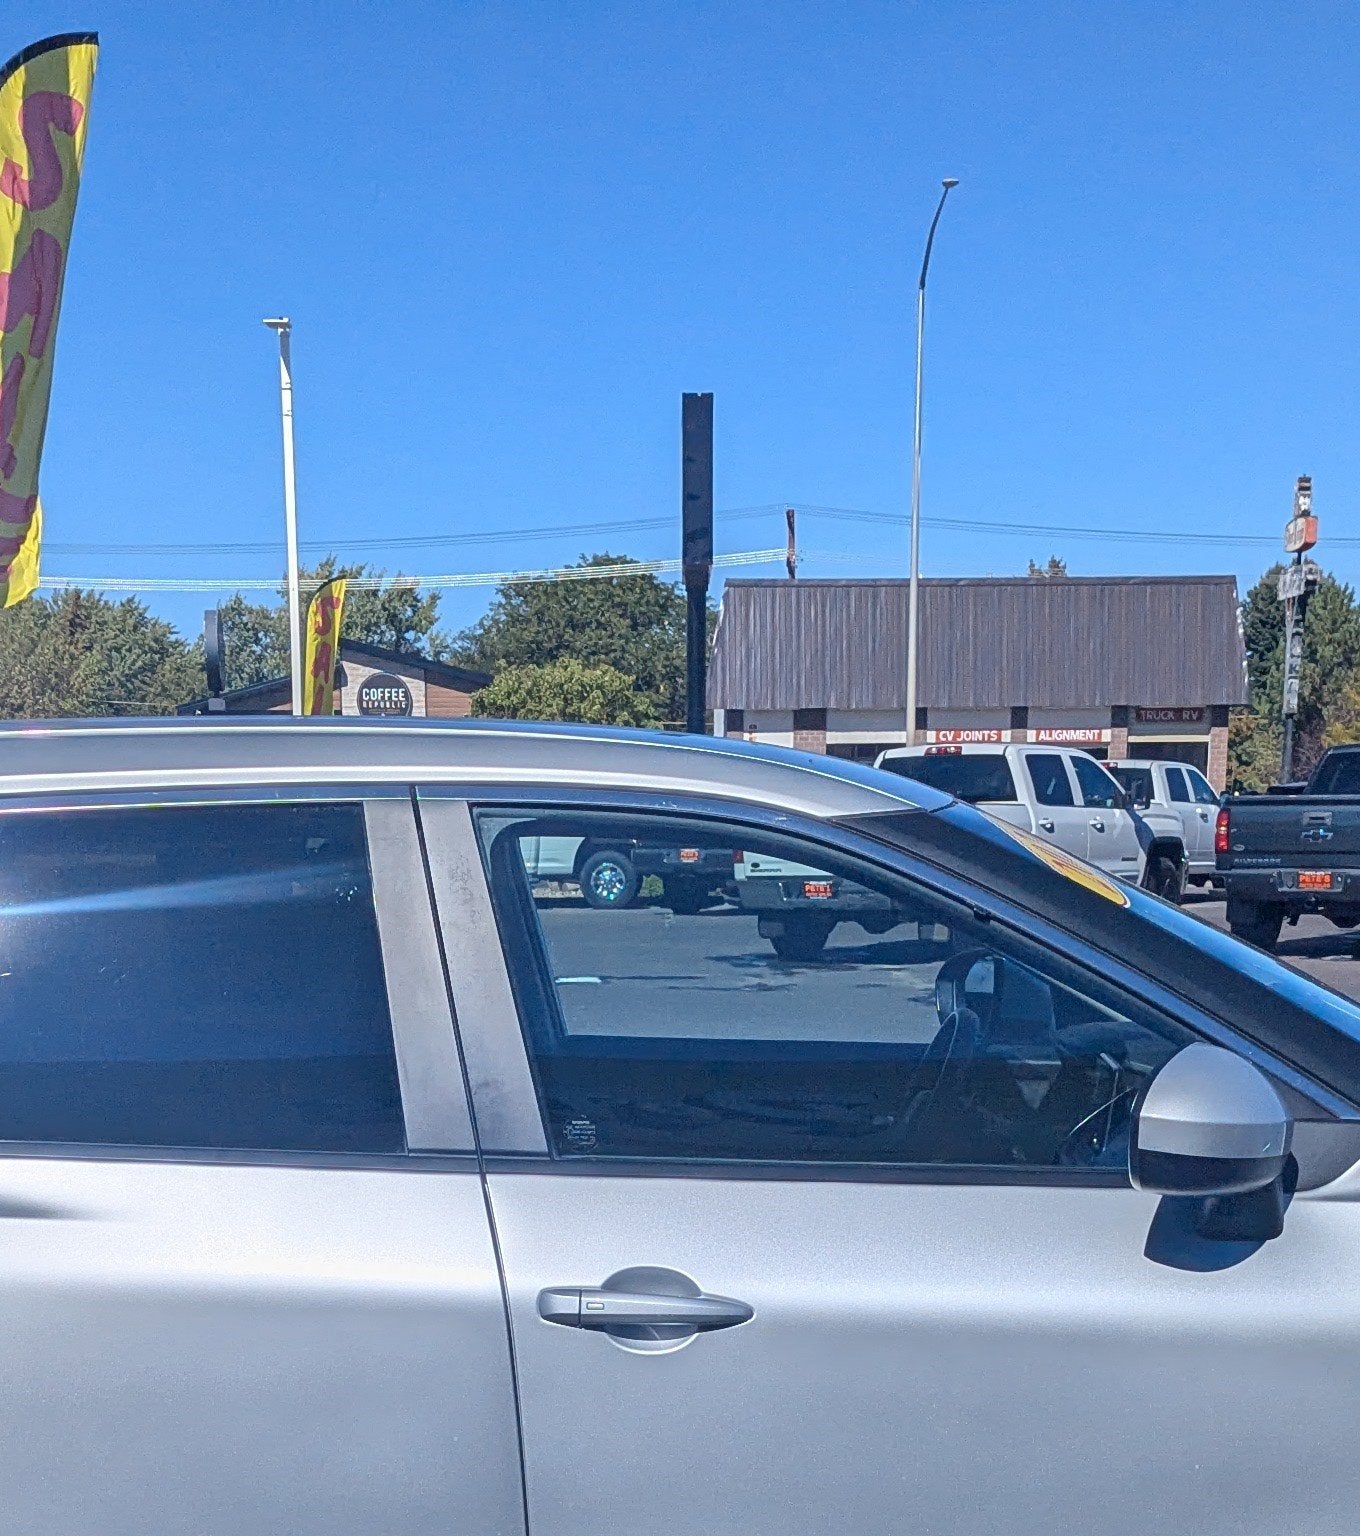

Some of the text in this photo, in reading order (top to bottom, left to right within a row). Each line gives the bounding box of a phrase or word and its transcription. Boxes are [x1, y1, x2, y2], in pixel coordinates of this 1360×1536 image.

[362, 688, 406, 700] COFFEE
[1140, 710, 1199, 720] TRUCK RV
[939, 730, 999, 741] CV JOINTS
[1039, 730, 1100, 741] ALIGNMENT
